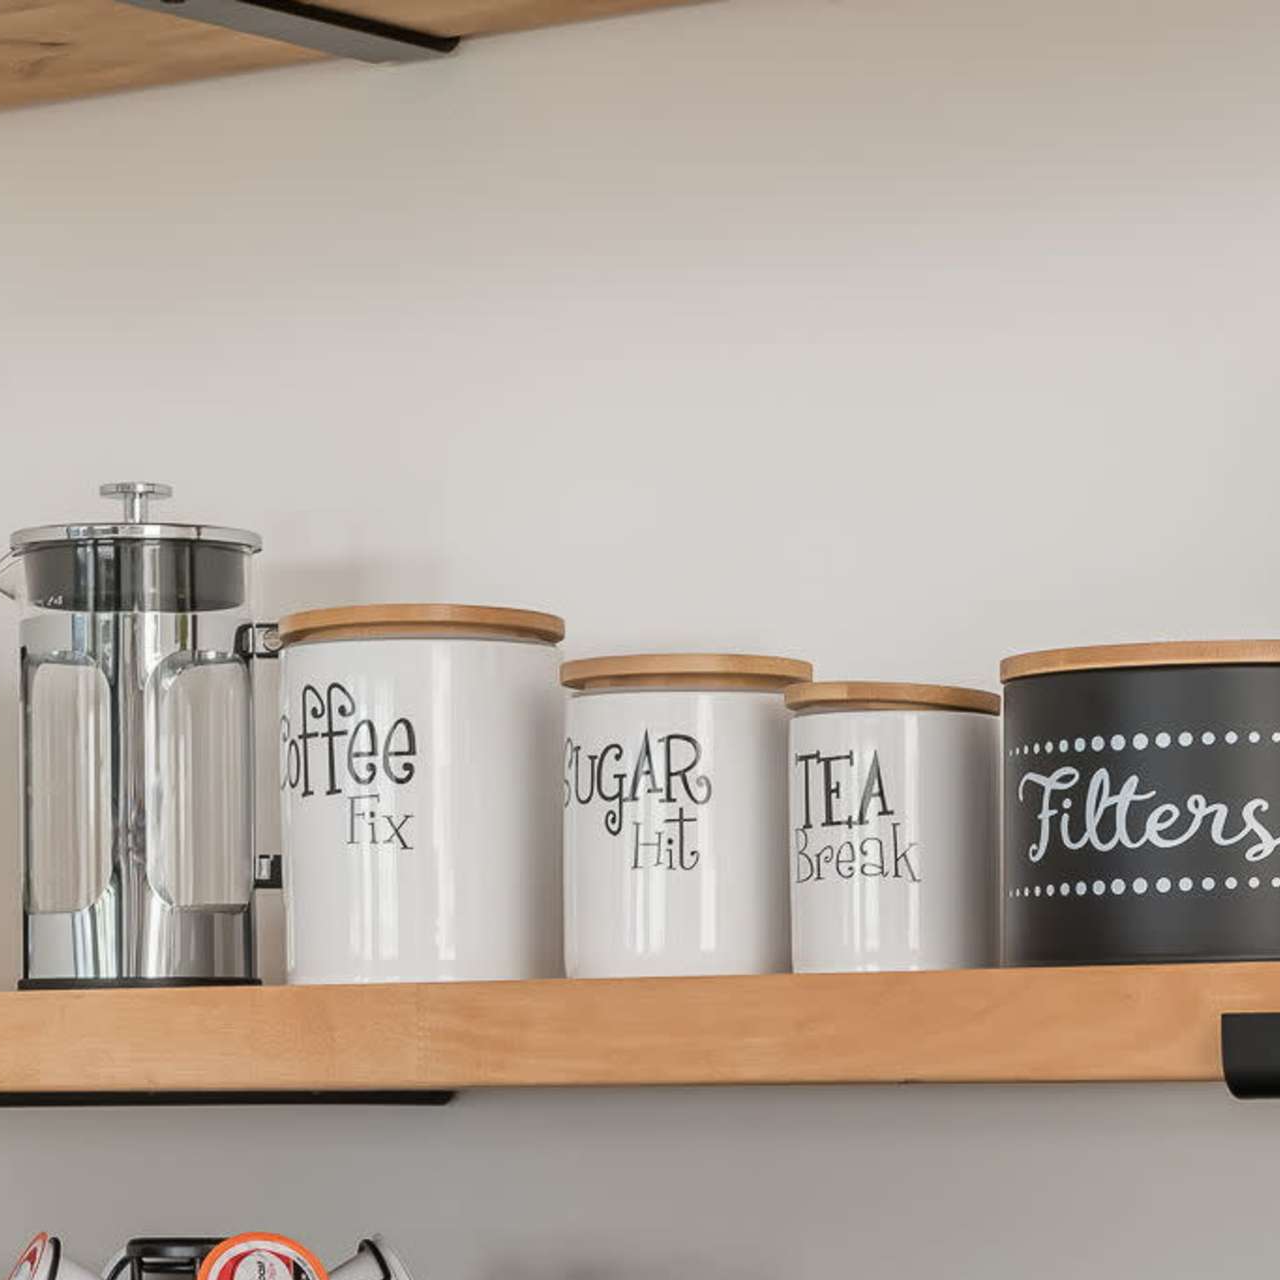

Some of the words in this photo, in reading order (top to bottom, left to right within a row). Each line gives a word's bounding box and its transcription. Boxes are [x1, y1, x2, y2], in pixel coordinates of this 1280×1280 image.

[795, 750, 894, 829] TEA
[347, 794, 415, 849] Fix
[631, 807, 700, 870] Hit
[795, 823, 922, 883] Break
